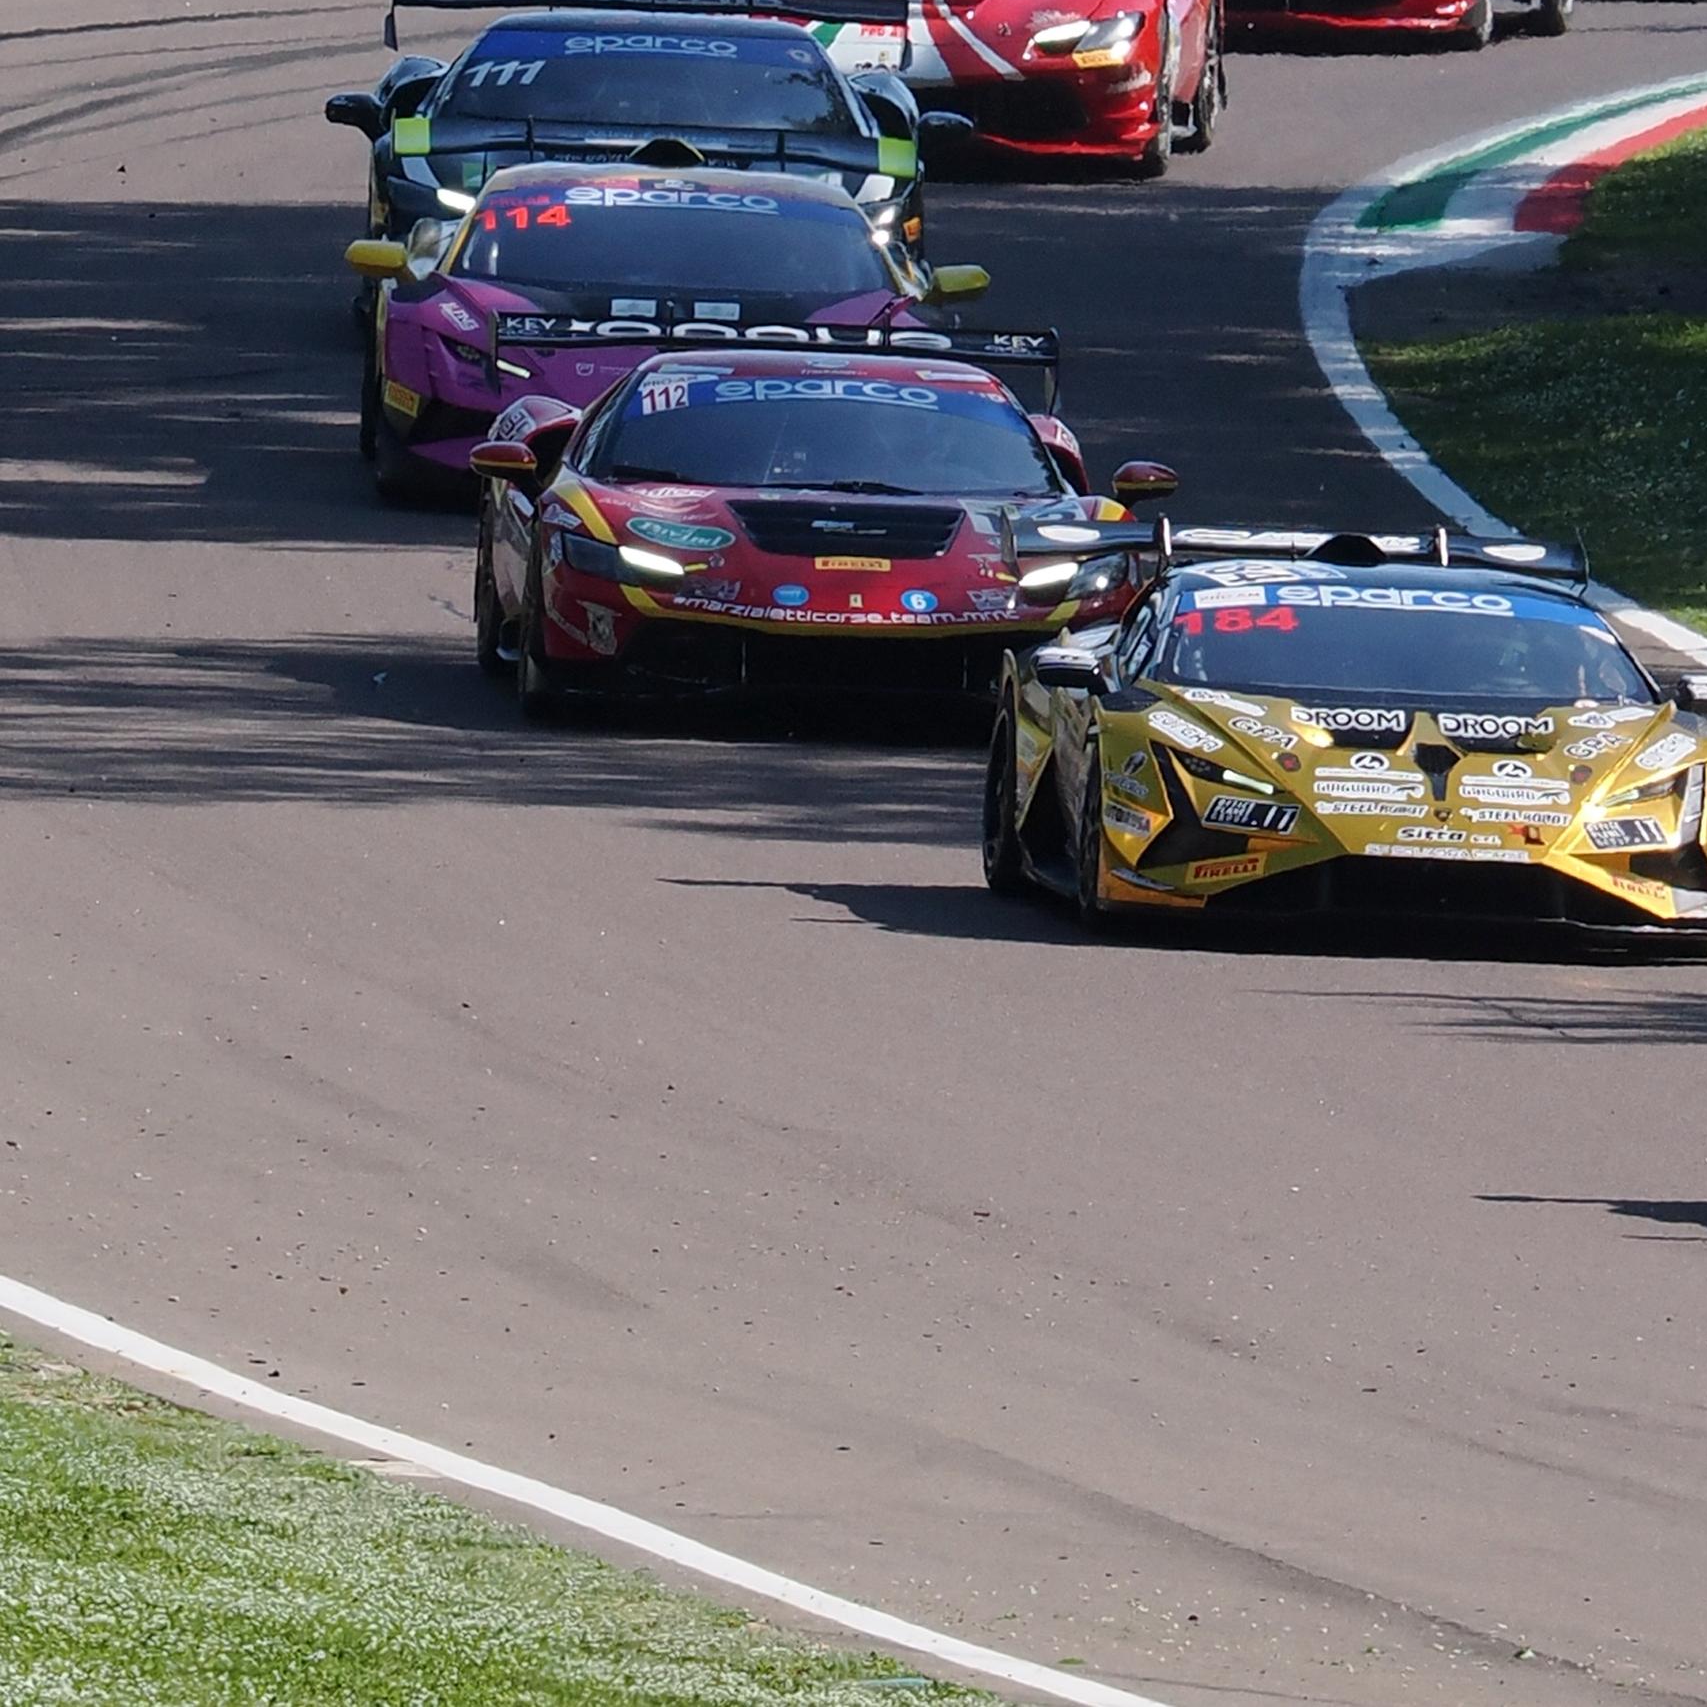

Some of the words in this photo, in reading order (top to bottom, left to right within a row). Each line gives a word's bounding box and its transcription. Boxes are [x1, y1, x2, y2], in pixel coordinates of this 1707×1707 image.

[563, 35, 738, 59] sparco
[466, 59, 546, 89] 111
[564, 185, 779, 216] sparco
[475, 204, 572, 231] 114
[506, 317, 557, 332] KEY
[993, 334, 1045, 348] KEY
[642, 384, 687, 413] 112
[714, 377, 939, 410] sparco
[1275, 584, 1515, 616] sparco
[1173, 605, 1299, 636] 184
[1293, 708, 1402, 729] DROOM
[1442, 715, 1550, 736] DROOM
